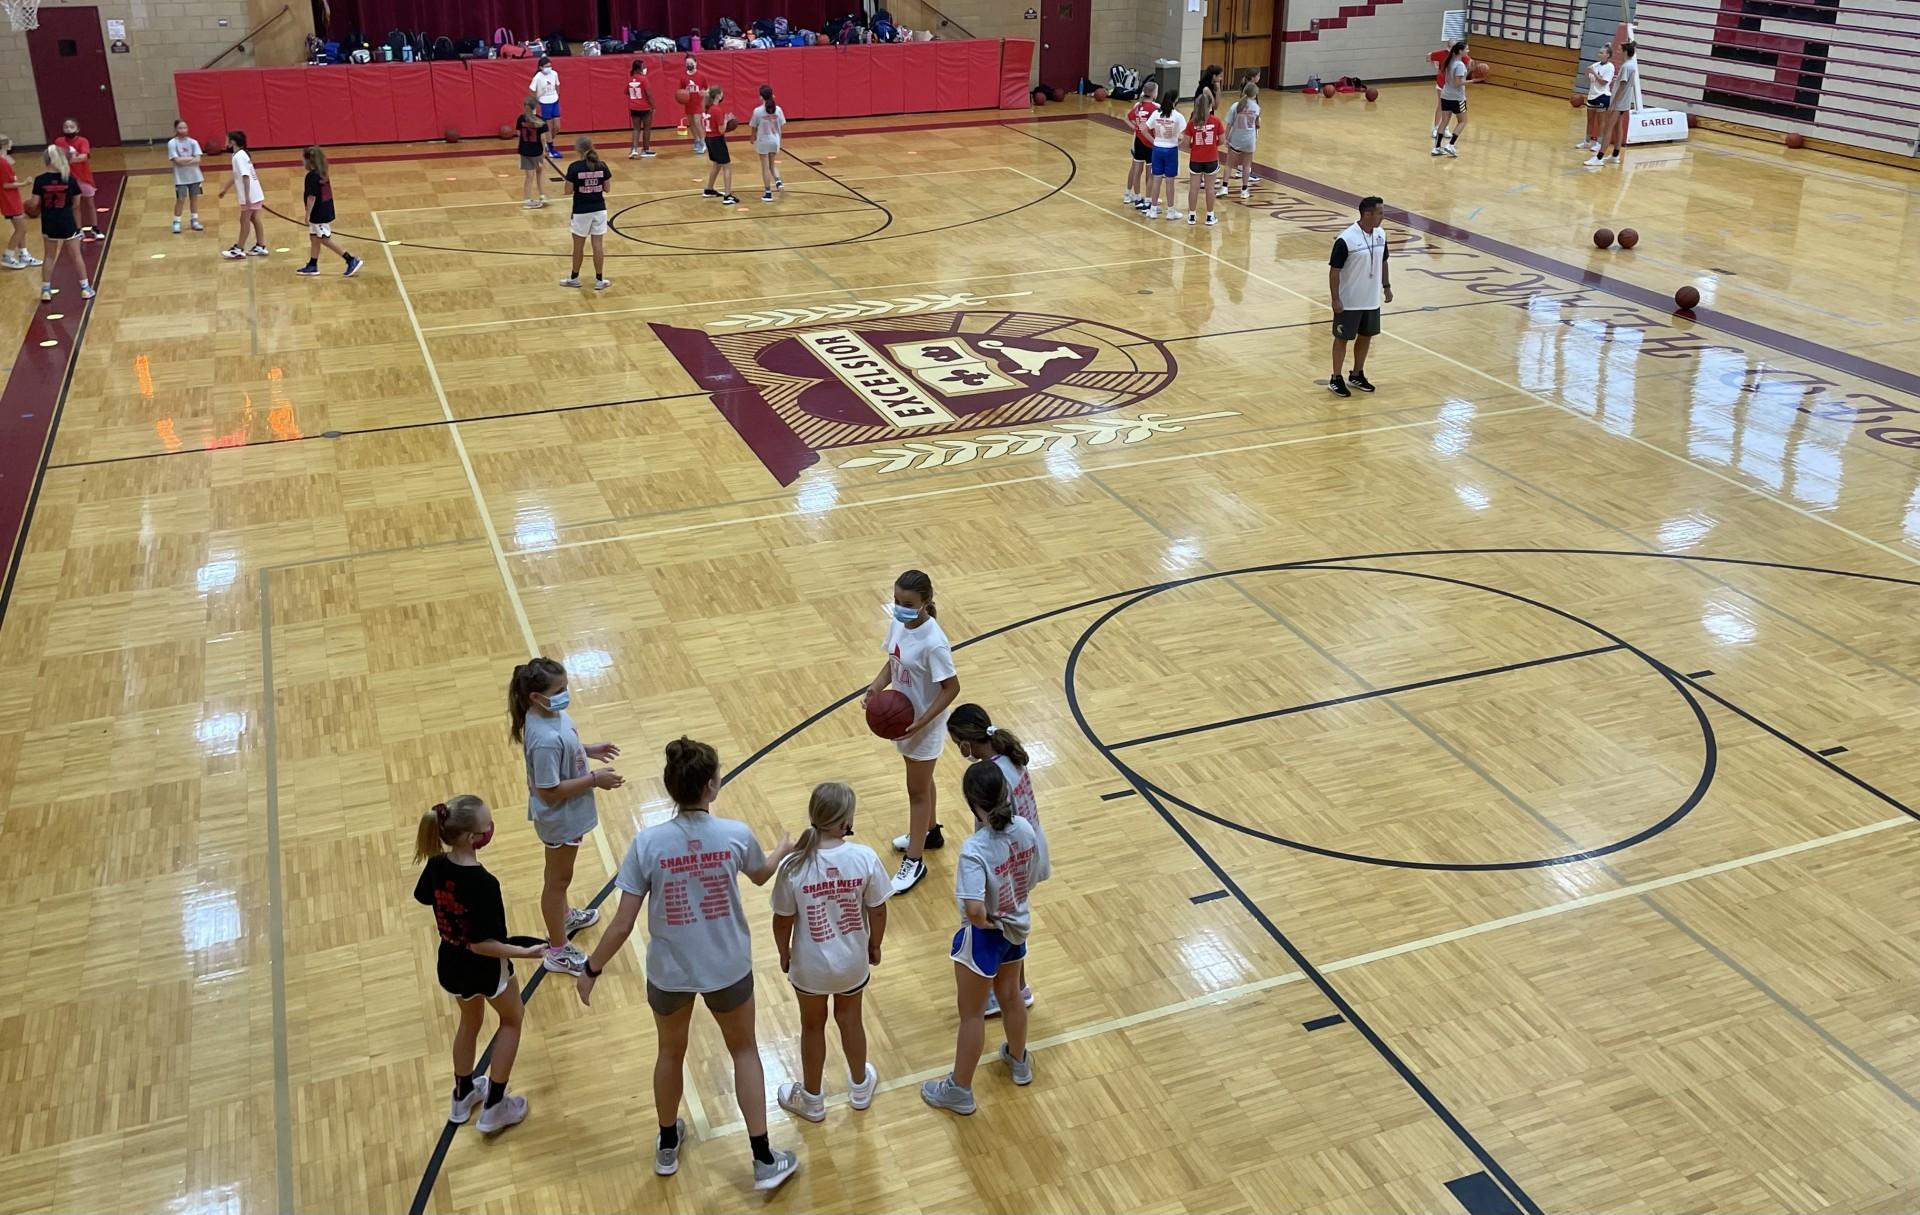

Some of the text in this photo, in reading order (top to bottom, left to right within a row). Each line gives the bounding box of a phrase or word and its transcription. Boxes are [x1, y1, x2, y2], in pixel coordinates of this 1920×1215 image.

[1641, 117, 1673, 127] GARED
[814, 335, 936, 418] EXCELSIOR
[660, 850, 731, 869] SHARK WEEK
[802, 878, 864, 894] SHARK WEEK
